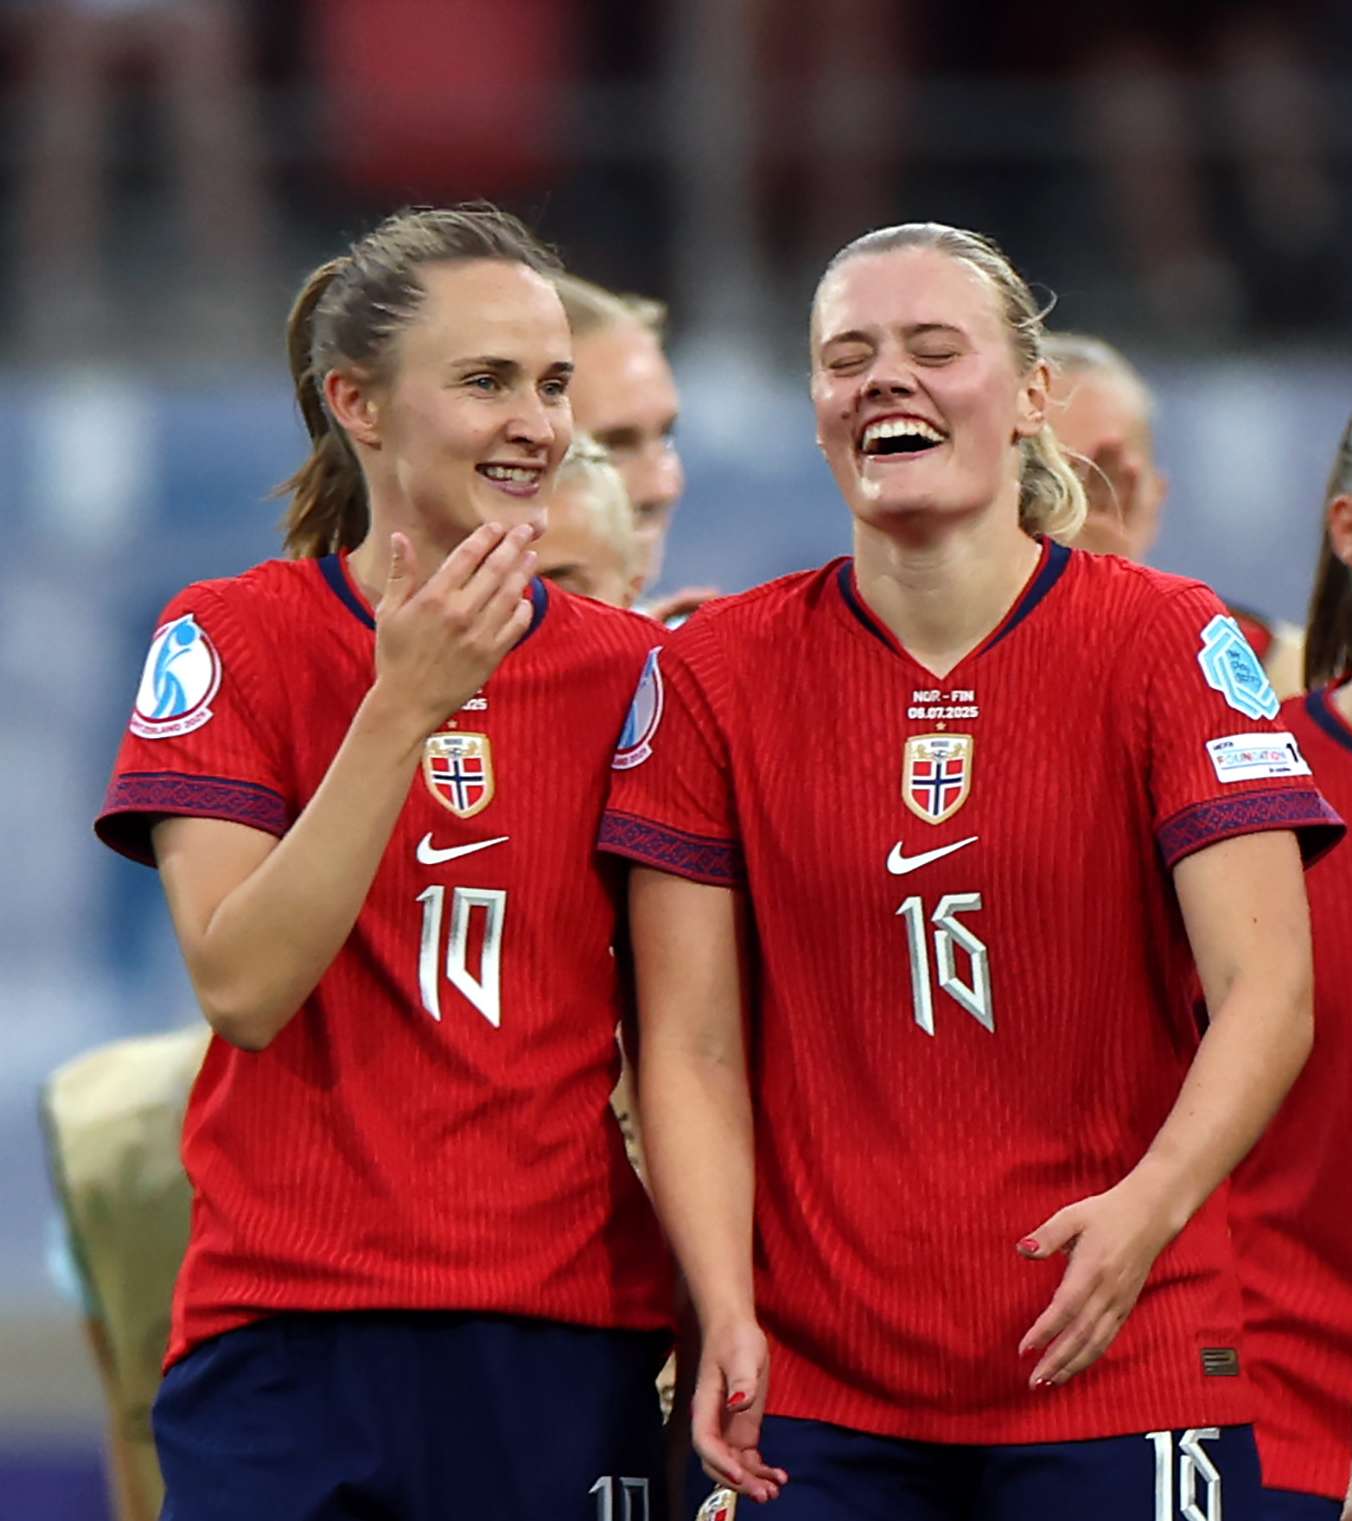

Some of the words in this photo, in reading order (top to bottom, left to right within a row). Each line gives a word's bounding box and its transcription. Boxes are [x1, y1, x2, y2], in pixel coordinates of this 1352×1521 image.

[913, 690, 940, 702] NOR
[951, 690, 975, 702] FIN
[416, 885, 507, 1028] 10
[895, 892, 995, 1036] 16
[1145, 1427, 1222, 1521] 16
